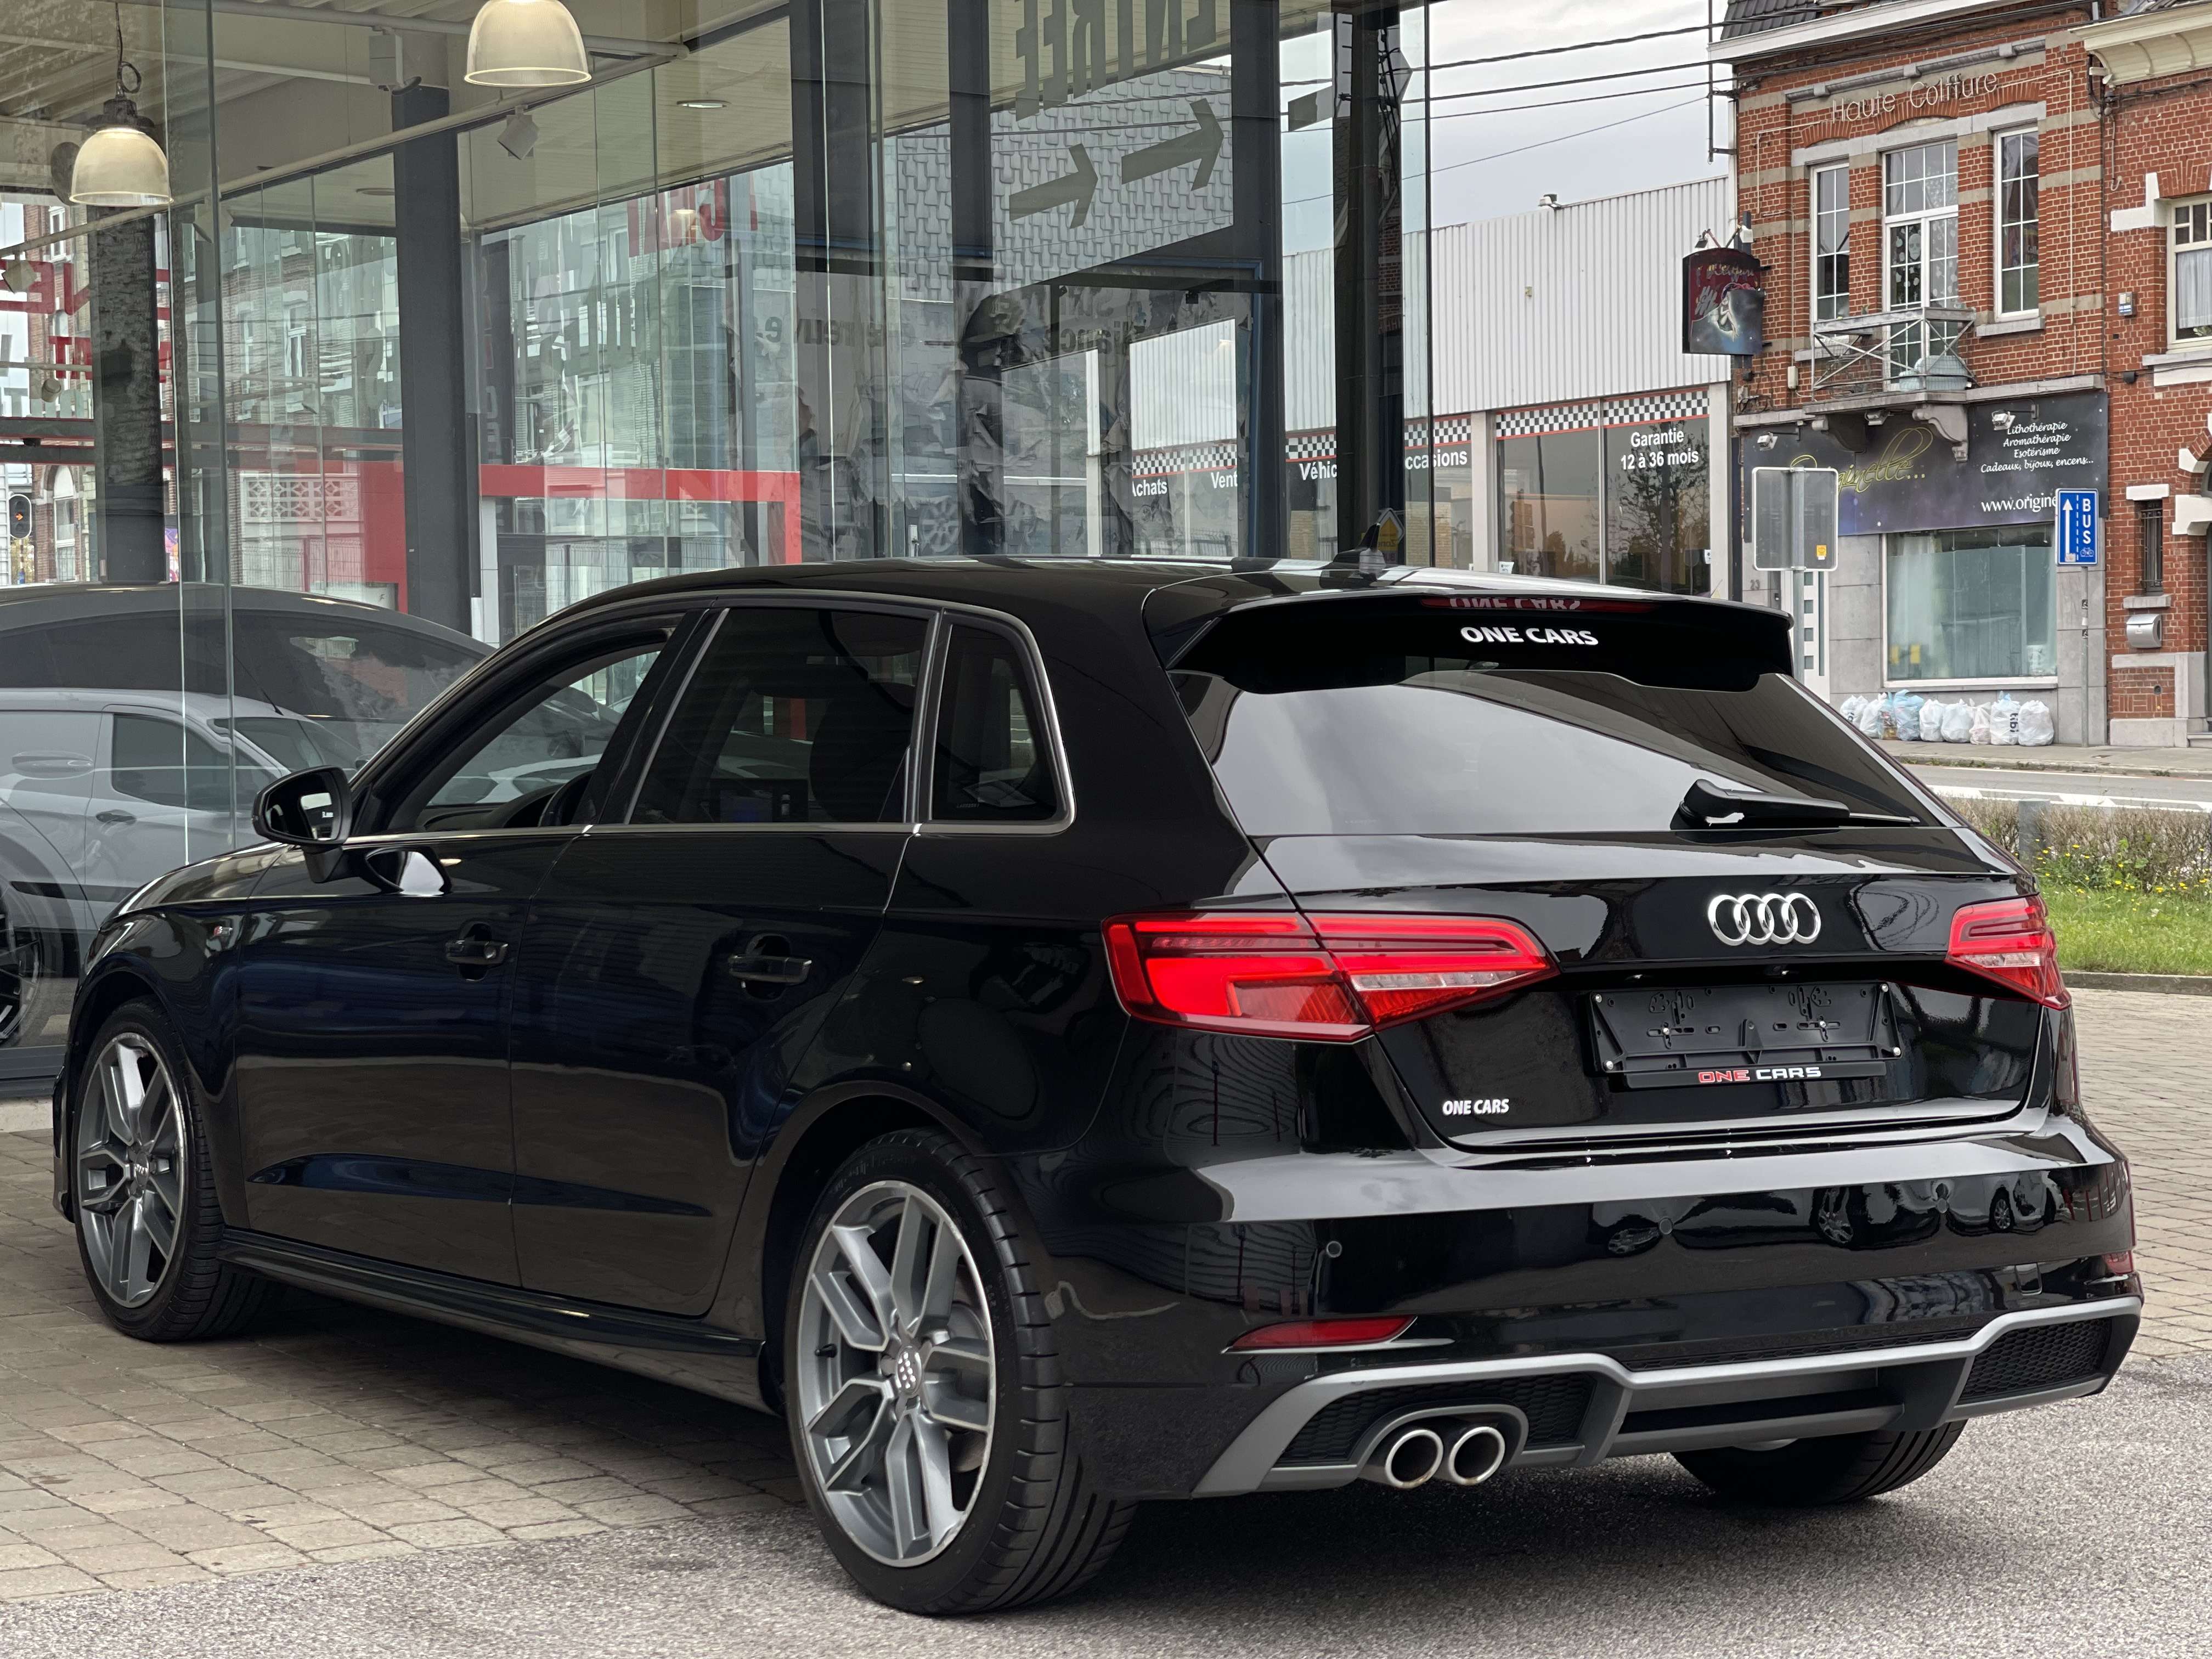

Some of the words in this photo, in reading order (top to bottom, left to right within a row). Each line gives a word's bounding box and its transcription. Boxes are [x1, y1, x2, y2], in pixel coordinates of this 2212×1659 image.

[1832, 90, 1895, 123] Haute
[1910, 72, 1997, 108] Coiffure
[2007, 421, 2068, 435] Lithothérapie
[1630, 428, 1684, 447] Garantie
[2003, 433, 2072, 447] Aromathérapie
[1621, 454, 1635, 470] 12
[1638, 453, 1646, 469] à
[1649, 450, 1664, 467] 36
[1667, 448, 1699, 465] mois
[2014, 447, 2061, 458] Esotérisme
[1980, 462, 2022, 473] Cadeaux,
[2024, 459, 2053, 472] bijoux,
[2056, 456, 2094, 466] encens...
[2083, 498, 2091, 544] BUS
[1750, 579, 1760, 590] 23
[1460, 626, 1524, 643] ONE
[1526, 628, 1599, 646] CARS
[1698, 1069, 1751, 1083] ONE
[1756, 1066, 1821, 1080] CARS
[1442, 1100, 1472, 1116] ONE
[1473, 1098, 1509, 1114] CARS
